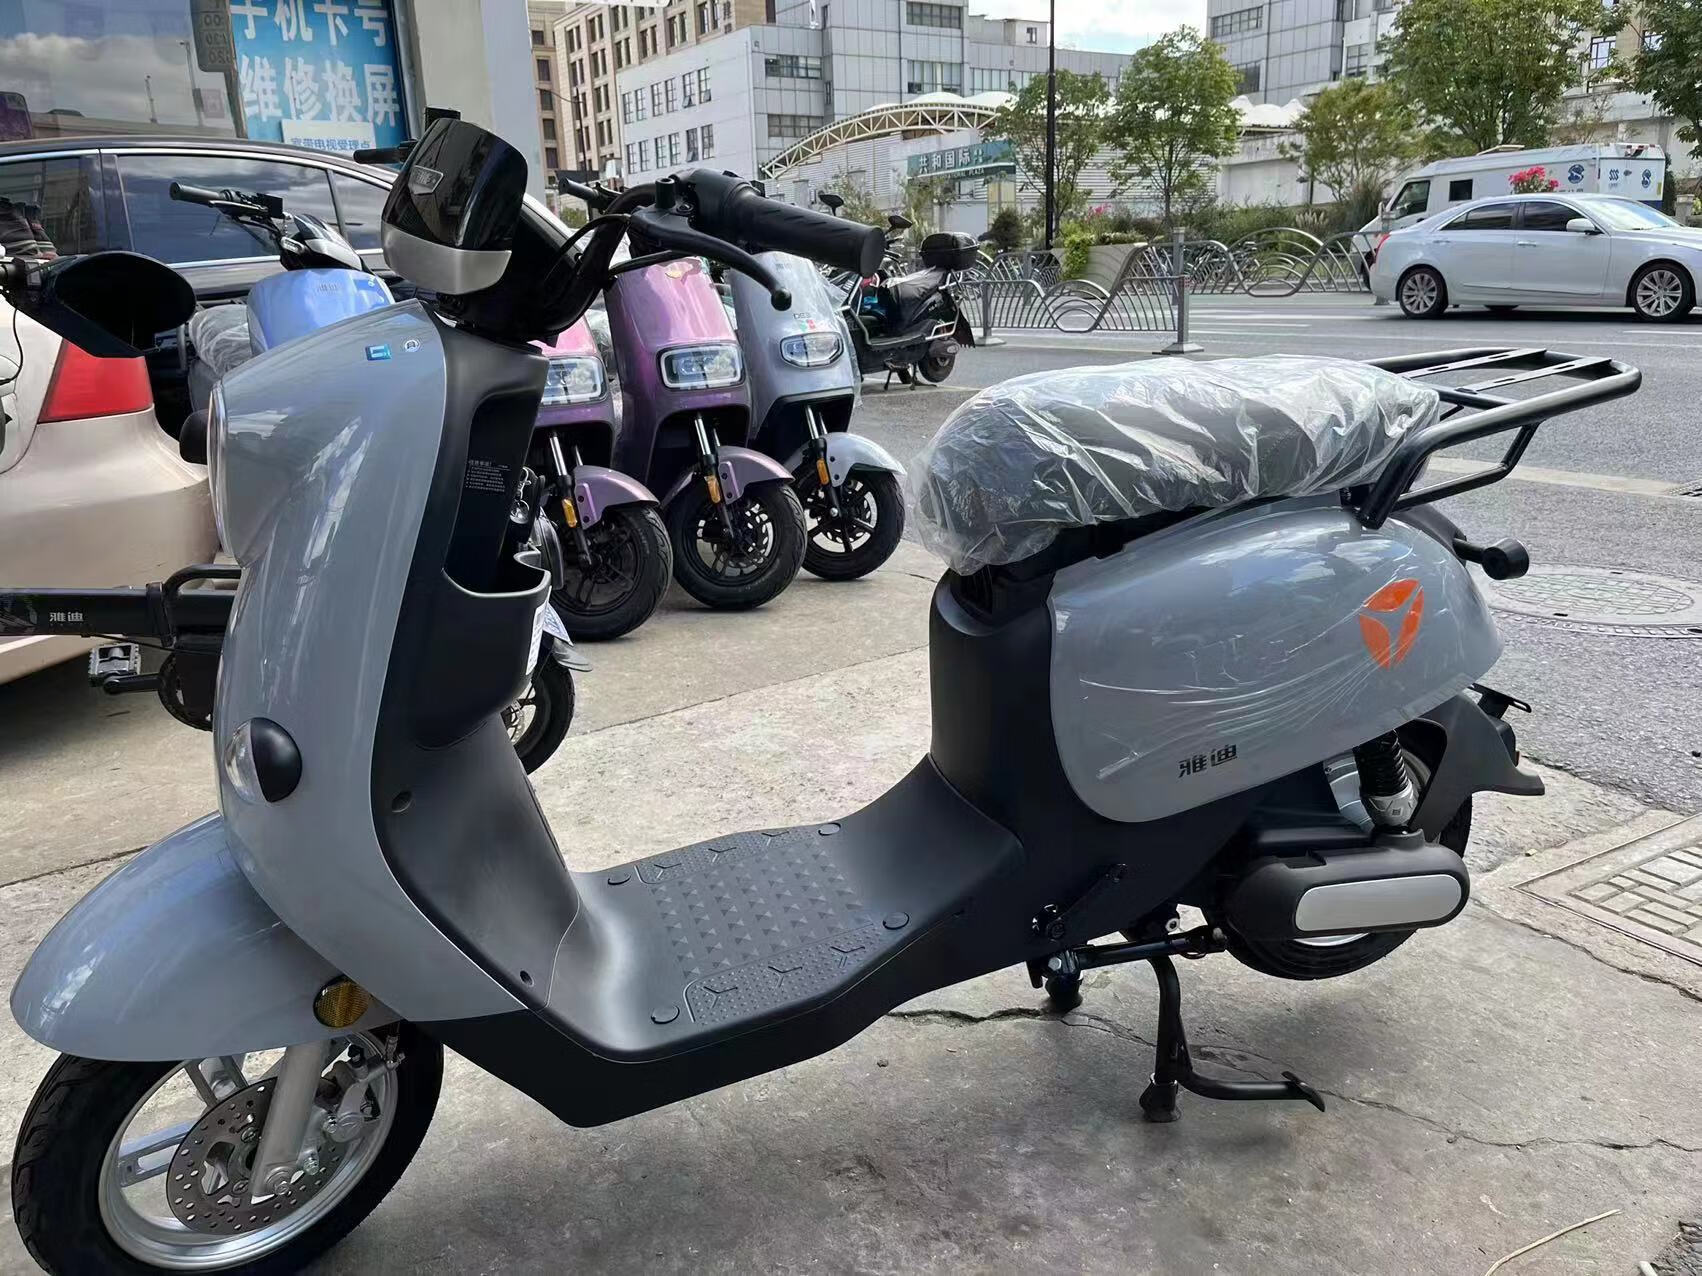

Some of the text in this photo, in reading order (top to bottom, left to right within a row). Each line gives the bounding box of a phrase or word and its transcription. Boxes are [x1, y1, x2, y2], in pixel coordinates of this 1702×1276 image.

[239, 54, 399, 127] 维修换屏
[49, 611, 84, 622] 雅迪
[1178, 744, 1238, 779] 雅迪
